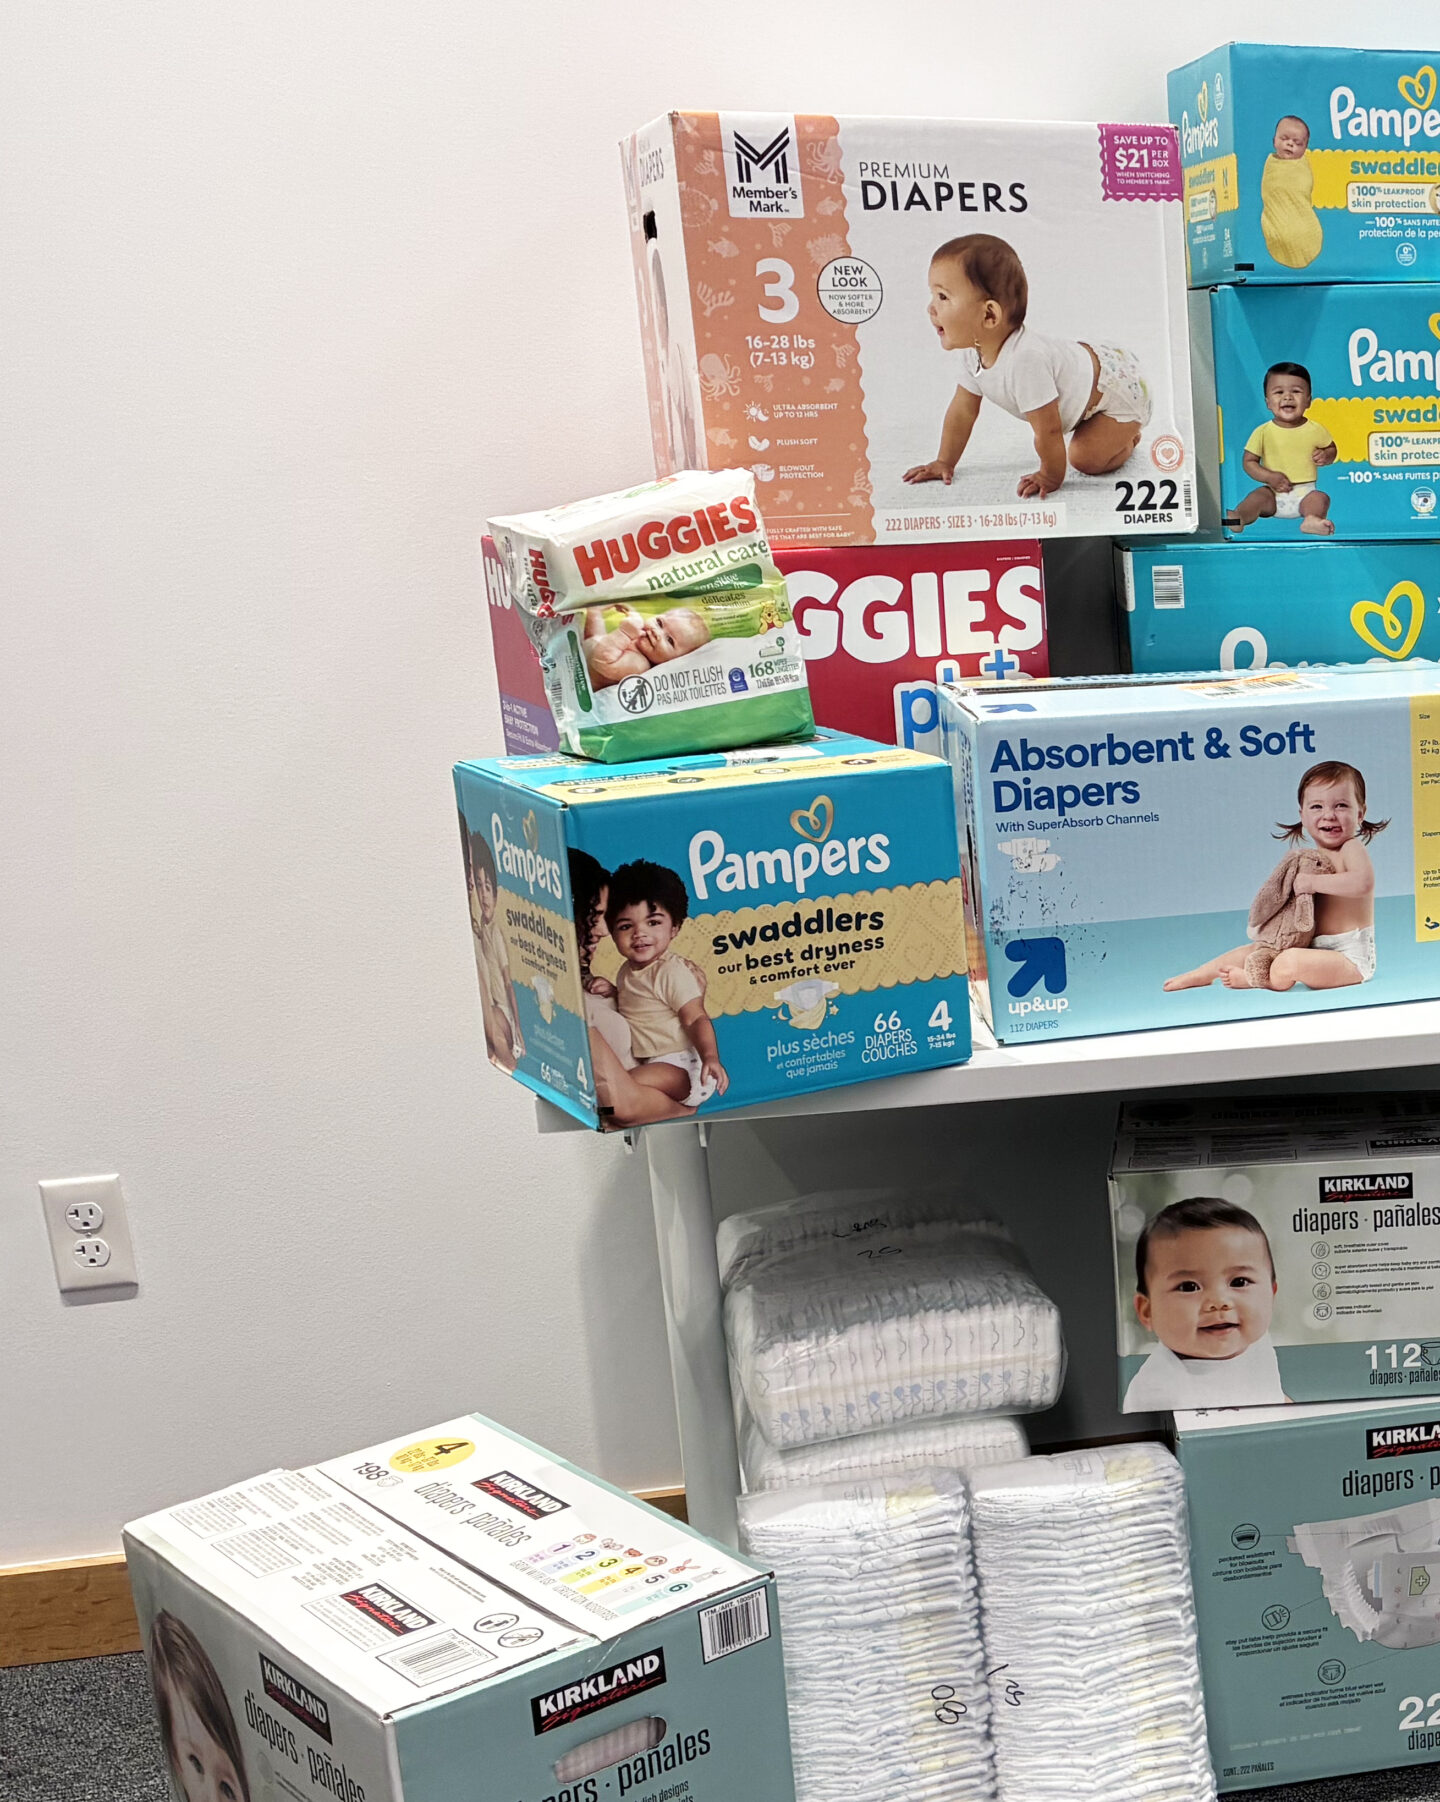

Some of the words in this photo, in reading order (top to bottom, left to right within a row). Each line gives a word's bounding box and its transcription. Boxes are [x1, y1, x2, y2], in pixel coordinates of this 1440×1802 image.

[1114, 136, 1138, 144] SAVE
[1140, 136, 1153, 145] UP
[1154, 137, 1168, 145] TO
[1115, 147, 1148, 170] $21
[1152, 150, 1168, 158] PER
[859, 161, 950, 179] PREMIUM
[732, 186, 797, 201] Member's
[861, 180, 1028, 213] DIAPERS
[1352, 199, 1371, 208] skin
[1375, 199, 1426, 210] protection
[832, 277, 868, 287] LOOK
[834, 266, 864, 275] NEW
[755, 258, 799, 323] 3
[745, 335, 790, 349] 16-28
[793, 335, 815, 348] lbs
[750, 352, 787, 367] (7-13
[791, 351, 814, 369] kg)
[1115, 480, 1179, 511] 222
[885, 518, 902, 531] 222
[904, 516, 940, 530] DIAPERS
[948, 515, 965, 528] SIZE
[967, 516, 972, 527] 3
[979, 514, 1004, 527] 16-28
[1005, 513, 1018, 525] lbs
[1020, 513, 1041, 527] (7-13
[1043, 512, 1056, 527] kg)
[1123, 512, 1172, 524] DIAPERS
[572, 496, 757, 588] HUGGIES
[727, 538, 768, 563] care
[646, 550, 724, 591] natural
[786, 567, 1043, 663] GGIES
[653, 674, 668, 692] DO
[670, 671, 690, 689] NOT
[692, 664, 723, 685] FLUSH
[749, 661, 774, 678] 168
[657, 692, 671, 705] PAS
[673, 689, 688, 703] AUX
[689, 682, 727, 699] TOILETTES
[990, 730, 1194, 773] Absorbent
[1203, 726, 1230, 757] &
[1239, 721, 1316, 755] Soft
[992, 777, 1140, 816] Diapers
[996, 820, 1024, 833] With
[1027, 814, 1103, 831] SuperAbsorb
[1106, 811, 1159, 825] Channels
[491, 812, 563, 901] Pampers
[688, 830, 890, 900] Pampers
[712, 908, 884, 954] swaddlers
[718, 961, 742, 975] our
[745, 949, 794, 971] best
[800, 935, 884, 969] dryness
[749, 975, 757, 985] &
[761, 966, 819, 984] comfort
[823, 959, 856, 975] ever
[928, 1000, 953, 1030] 4
[1008, 996, 1069, 1018] up&up
[874, 1012, 901, 1032] 66
[1010, 1021, 1023, 1033] 112
[1026, 1019, 1058, 1032] DIAPERS
[767, 1040, 799, 1062] plus
[803, 1029, 855, 1052] sèches
[861, 1041, 918, 1064] COUCHES
[865, 1028, 912, 1052] DIAPERS
[1324, 1175, 1409, 1192] KIRKLAND
[1293, 1207, 1358, 1234] diapers
[1366, 1343, 1420, 1369] 112
[435, 1442, 469, 1456] 4
[353, 1461, 389, 1481] 198
[1342, 1469, 1414, 1498] diapers
[490, 1473, 563, 1514] KIRKLAND
[414, 1481, 474, 1515] diapers
[464, 1511, 532, 1548] pañales
[263, 1657, 326, 1722] KIRKLAND
[539, 1654, 660, 1718] KIRKLAND
